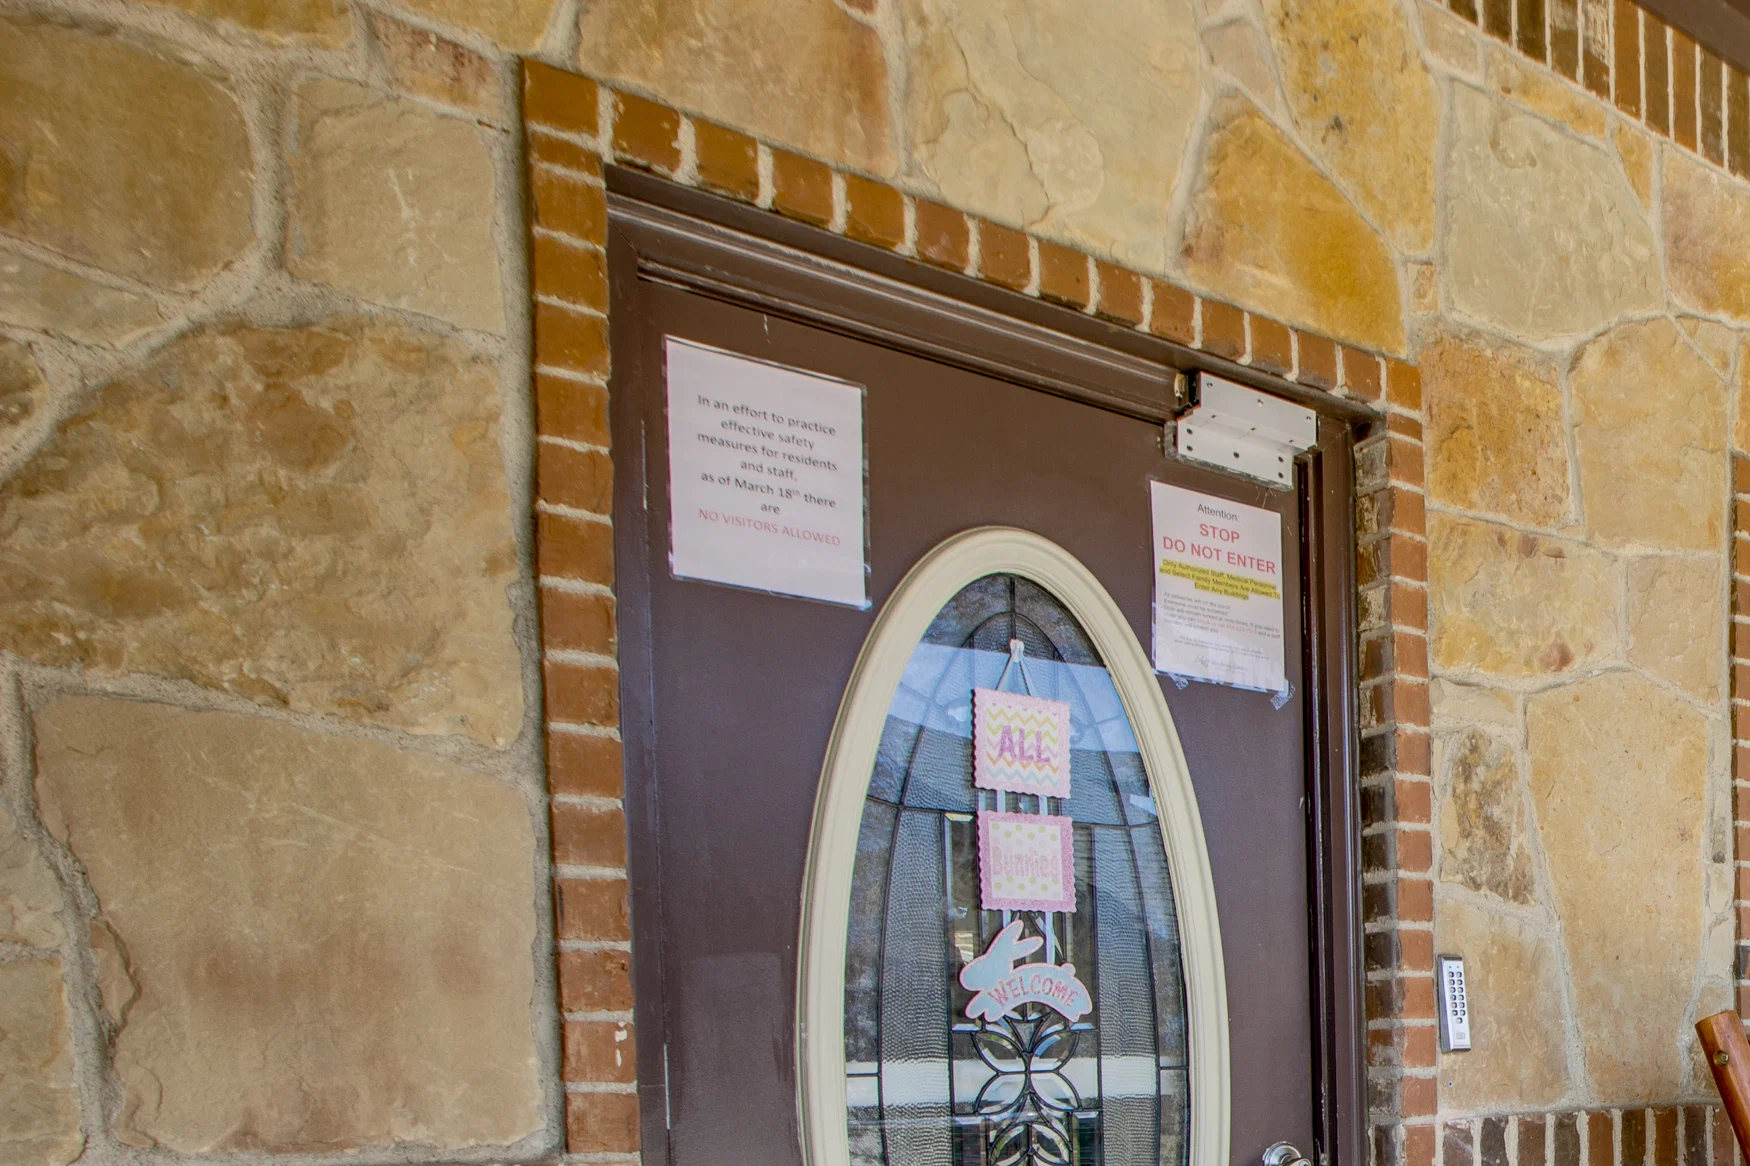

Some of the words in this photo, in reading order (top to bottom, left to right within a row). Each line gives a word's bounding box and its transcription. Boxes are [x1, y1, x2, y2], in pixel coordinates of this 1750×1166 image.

[697, 394, 710, 407] In
[714, 400, 729, 412] an
[733, 403, 768, 421] effort
[771, 413, 784, 424] to
[787, 416, 836, 436] practice
[720, 420, 775, 439] effective
[778, 432, 815, 451] safety
[697, 433, 758, 454] measures
[761, 445, 779, 458] for
[782, 451, 837, 472] residents
[740, 459, 763, 473] and
[767, 466, 797, 482] staff,
[701, 472, 714, 482] as
[718, 475, 731, 485] of
[734, 477, 774, 496] March
[778, 487, 801, 500] 18th
[804, 492, 836, 508] there
[760, 502, 780, 515] are
[1197, 503, 1240, 522] Attention:
[699, 508, 719, 522] NO
[722, 513, 778, 533] VISITORS
[782, 526, 841, 546] ALLOWED
[1199, 523, 1240, 543] STOP
[1163, 536, 1185, 552] DO
[1191, 543, 1223, 561] NOT
[1228, 552, 1276, 574] ENTER
[1163, 560, 1177, 568] Only
[1179, 563, 1209, 575] Authorized
[1227, 574, 1248, 583] Medical
[1173, 570, 1190, 579] Select
[1212, 579, 1238, 590] Members
[1251, 587, 1272, 597] Allowed
[1195, 582, 1210, 590] Enter
[1211, 586, 1222, 594] Any
[999, 725, 1052, 765] ALL
[991, 845, 1059, 880] Bunnies
[988, 974, 1079, 1008] WELCOME
